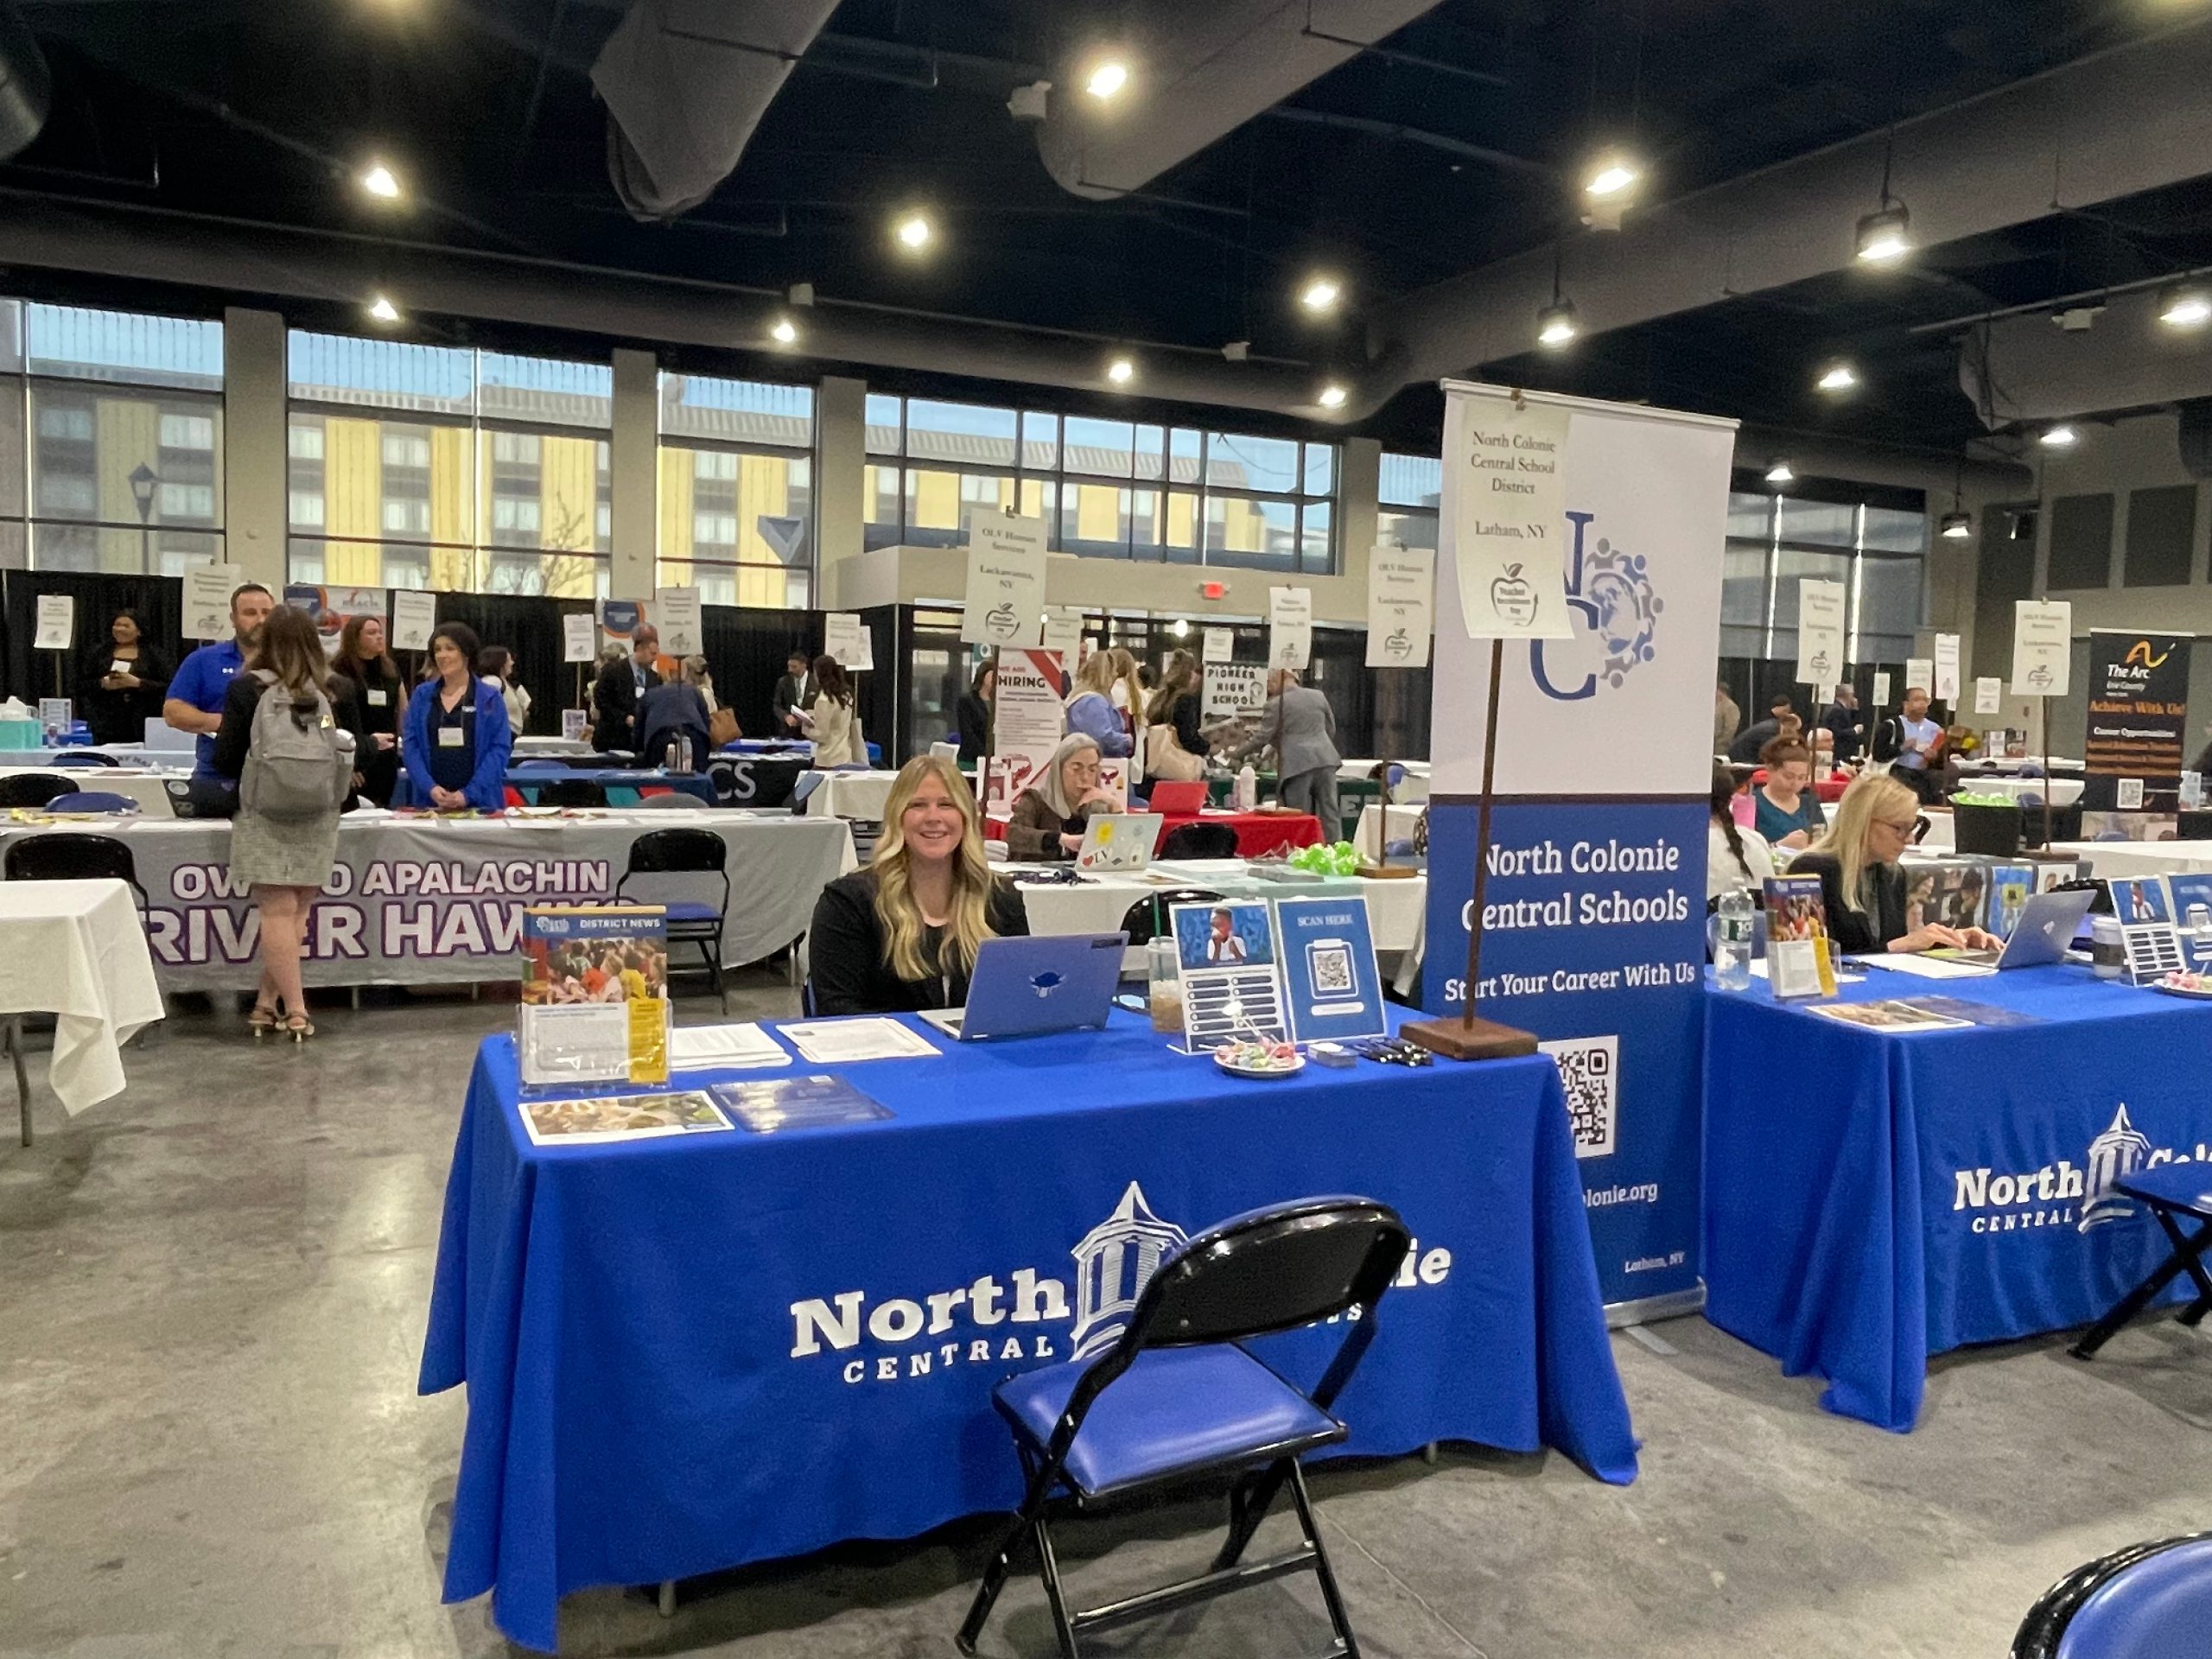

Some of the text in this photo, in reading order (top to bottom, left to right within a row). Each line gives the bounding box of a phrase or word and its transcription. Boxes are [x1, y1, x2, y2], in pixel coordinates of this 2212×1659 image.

[1472, 430, 1556, 453] North Colonie
[1471, 453, 1555, 474] Central School
[1491, 477, 1535, 494] District
[1475, 520, 1548, 539] Latham, NY
[997, 675, 1046, 689] HIRING
[1207, 668, 1255, 679] PIONEER
[2107, 664, 2151, 679] The Arc
[1217, 682, 1244, 692] HIGH
[1212, 695, 1255, 705] SCHOOL
[1485, 837, 1680, 877] North Colonie
[173, 861, 609, 900] OWO APALACHIN
[1580, 888, 1688, 925] Schools
[580, 918, 626, 929] DISTRICT
[629, 918, 661, 928] NEWS
[1297, 913, 1354, 927] SCAN HERE
[138, 903, 366, 964] RIVR
[1501, 972, 1548, 996] Your
[1552, 969, 1621, 993] Career
[1624, 963, 1671, 987] With
[1675, 962, 1695, 984] Us
[1953, 1160, 2084, 1211] North
[1971, 1208, 2073, 1234] CENTRAL
[789, 1268, 1071, 1358] North
[842, 1335, 1054, 1384] CENTRAL
